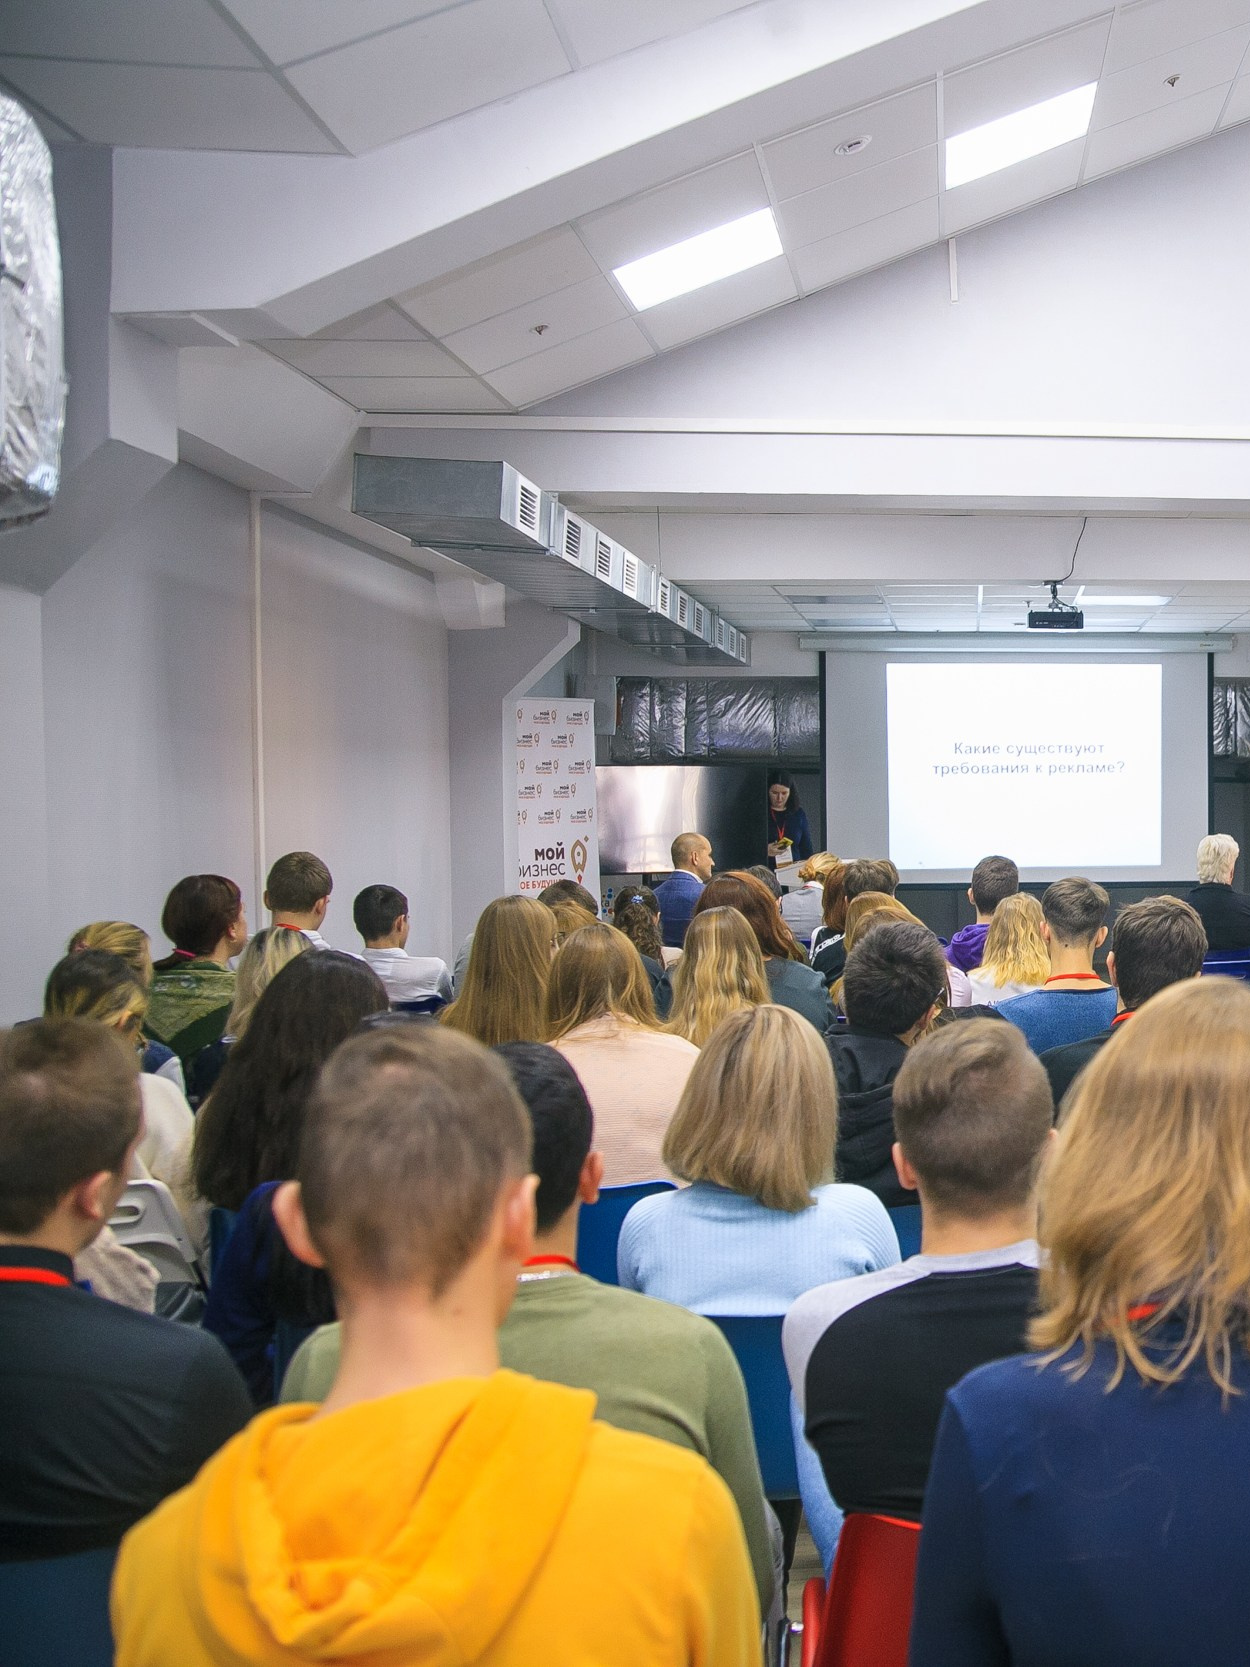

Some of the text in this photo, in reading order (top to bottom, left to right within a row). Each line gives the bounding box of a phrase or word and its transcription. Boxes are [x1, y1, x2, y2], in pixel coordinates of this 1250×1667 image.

[954, 742, 1105, 757] Какие существуют
[932, 761, 1126, 777] требования к рекламе?
[519, 881, 530, 889] ОЕ
